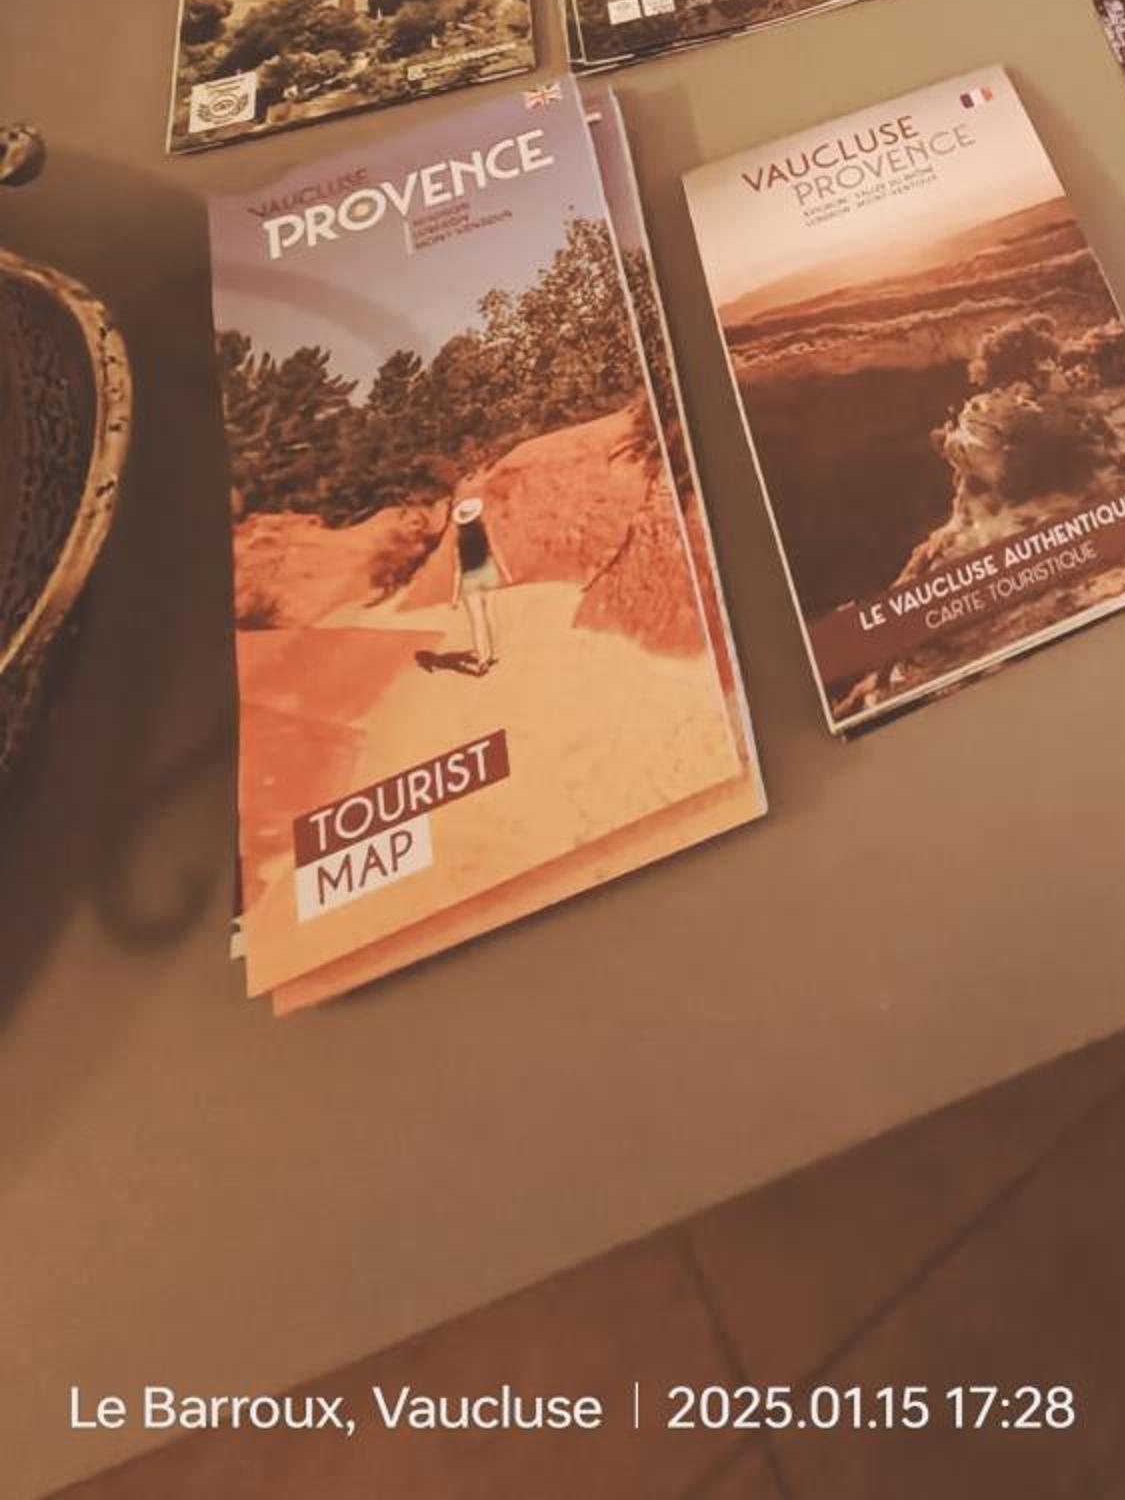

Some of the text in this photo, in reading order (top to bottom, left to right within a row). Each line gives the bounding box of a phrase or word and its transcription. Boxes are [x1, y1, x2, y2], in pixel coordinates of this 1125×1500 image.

[262, 129, 555, 260] PROVENCE
[741, 116, 920, 192] VAUCLUSE
[793, 124, 976, 206] PROVENCE
[859, 604, 887, 631] LE
[889, 555, 998, 617] VAUCLUSE
[925, 540, 1098, 629] CARTE TOURISTIQUE
[309, 740, 491, 852] TOURIST
[317, 830, 414, 906] MAP
